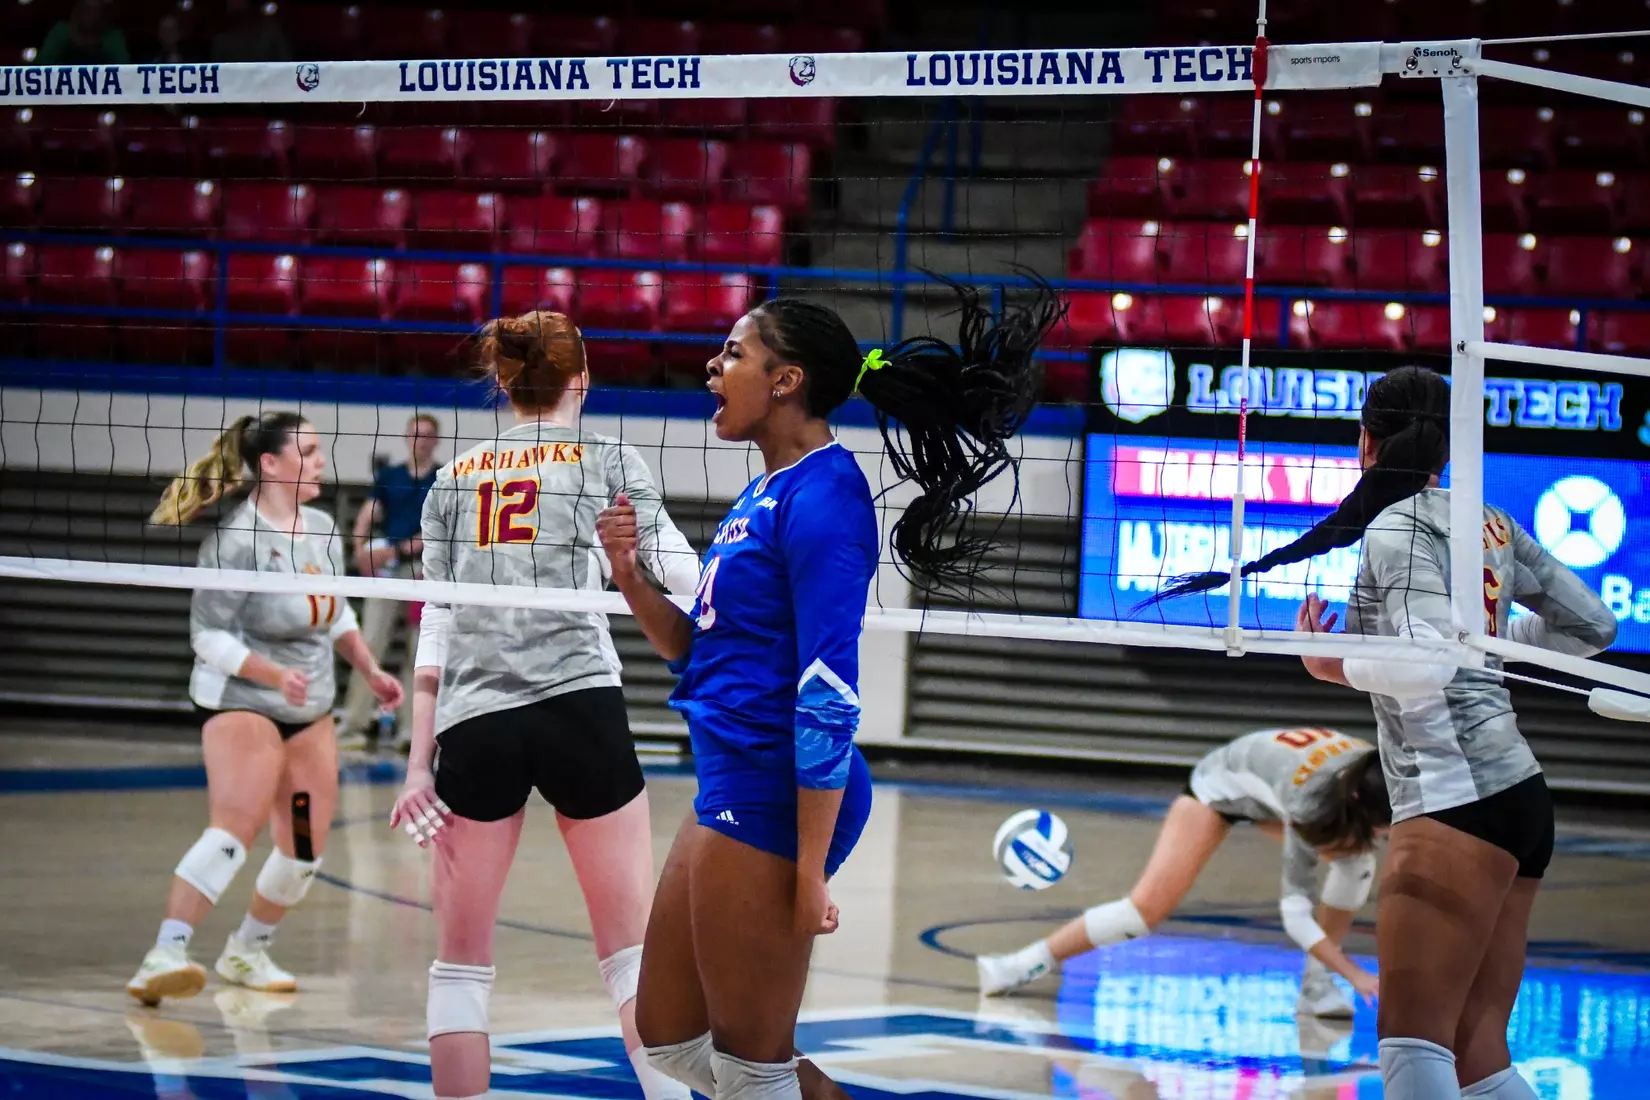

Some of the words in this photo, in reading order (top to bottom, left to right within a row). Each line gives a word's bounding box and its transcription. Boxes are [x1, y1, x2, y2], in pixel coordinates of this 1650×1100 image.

[906, 51, 1125, 86] LOUISIANA
[1144, 47, 1253, 83] TECH
[1290, 56, 1312, 65] sports
[1313, 55, 1341, 64] imports
[1422, 48, 1458, 57] Senoh
[137, 64, 220, 95] TECH
[399, 58, 590, 92] LOUISIANA
[606, 58, 701, 90] TECH
[1187, 363, 1372, 420] LOUISI
[1484, 376, 1624, 431] TECH
[1136, 449, 1275, 503] THANK
[476, 477, 541, 550] 12
